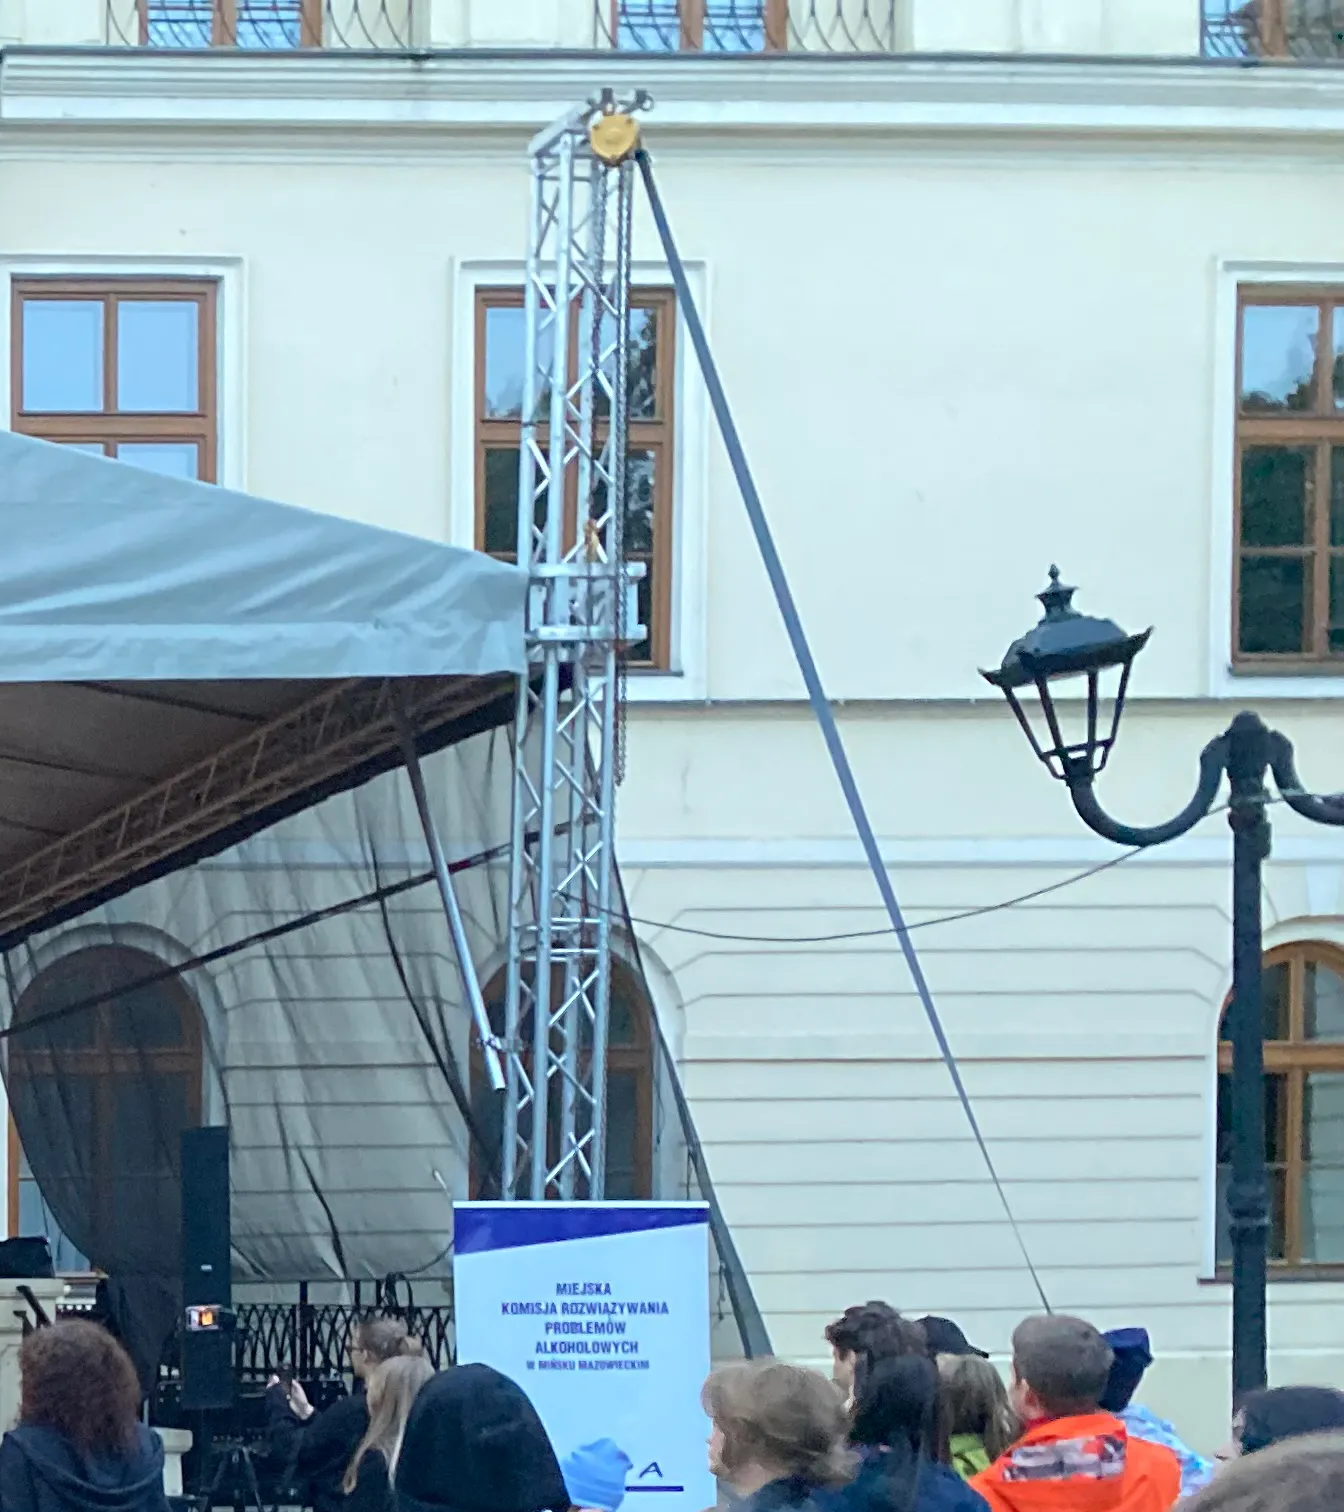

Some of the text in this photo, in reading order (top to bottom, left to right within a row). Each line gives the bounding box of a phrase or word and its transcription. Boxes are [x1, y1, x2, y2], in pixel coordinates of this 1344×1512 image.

[556, 1282, 612, 1296] MIEJSKA
[501, 1302, 557, 1315] KOMISJA
[535, 1341, 639, 1354] ALKOHOLOWYCH
